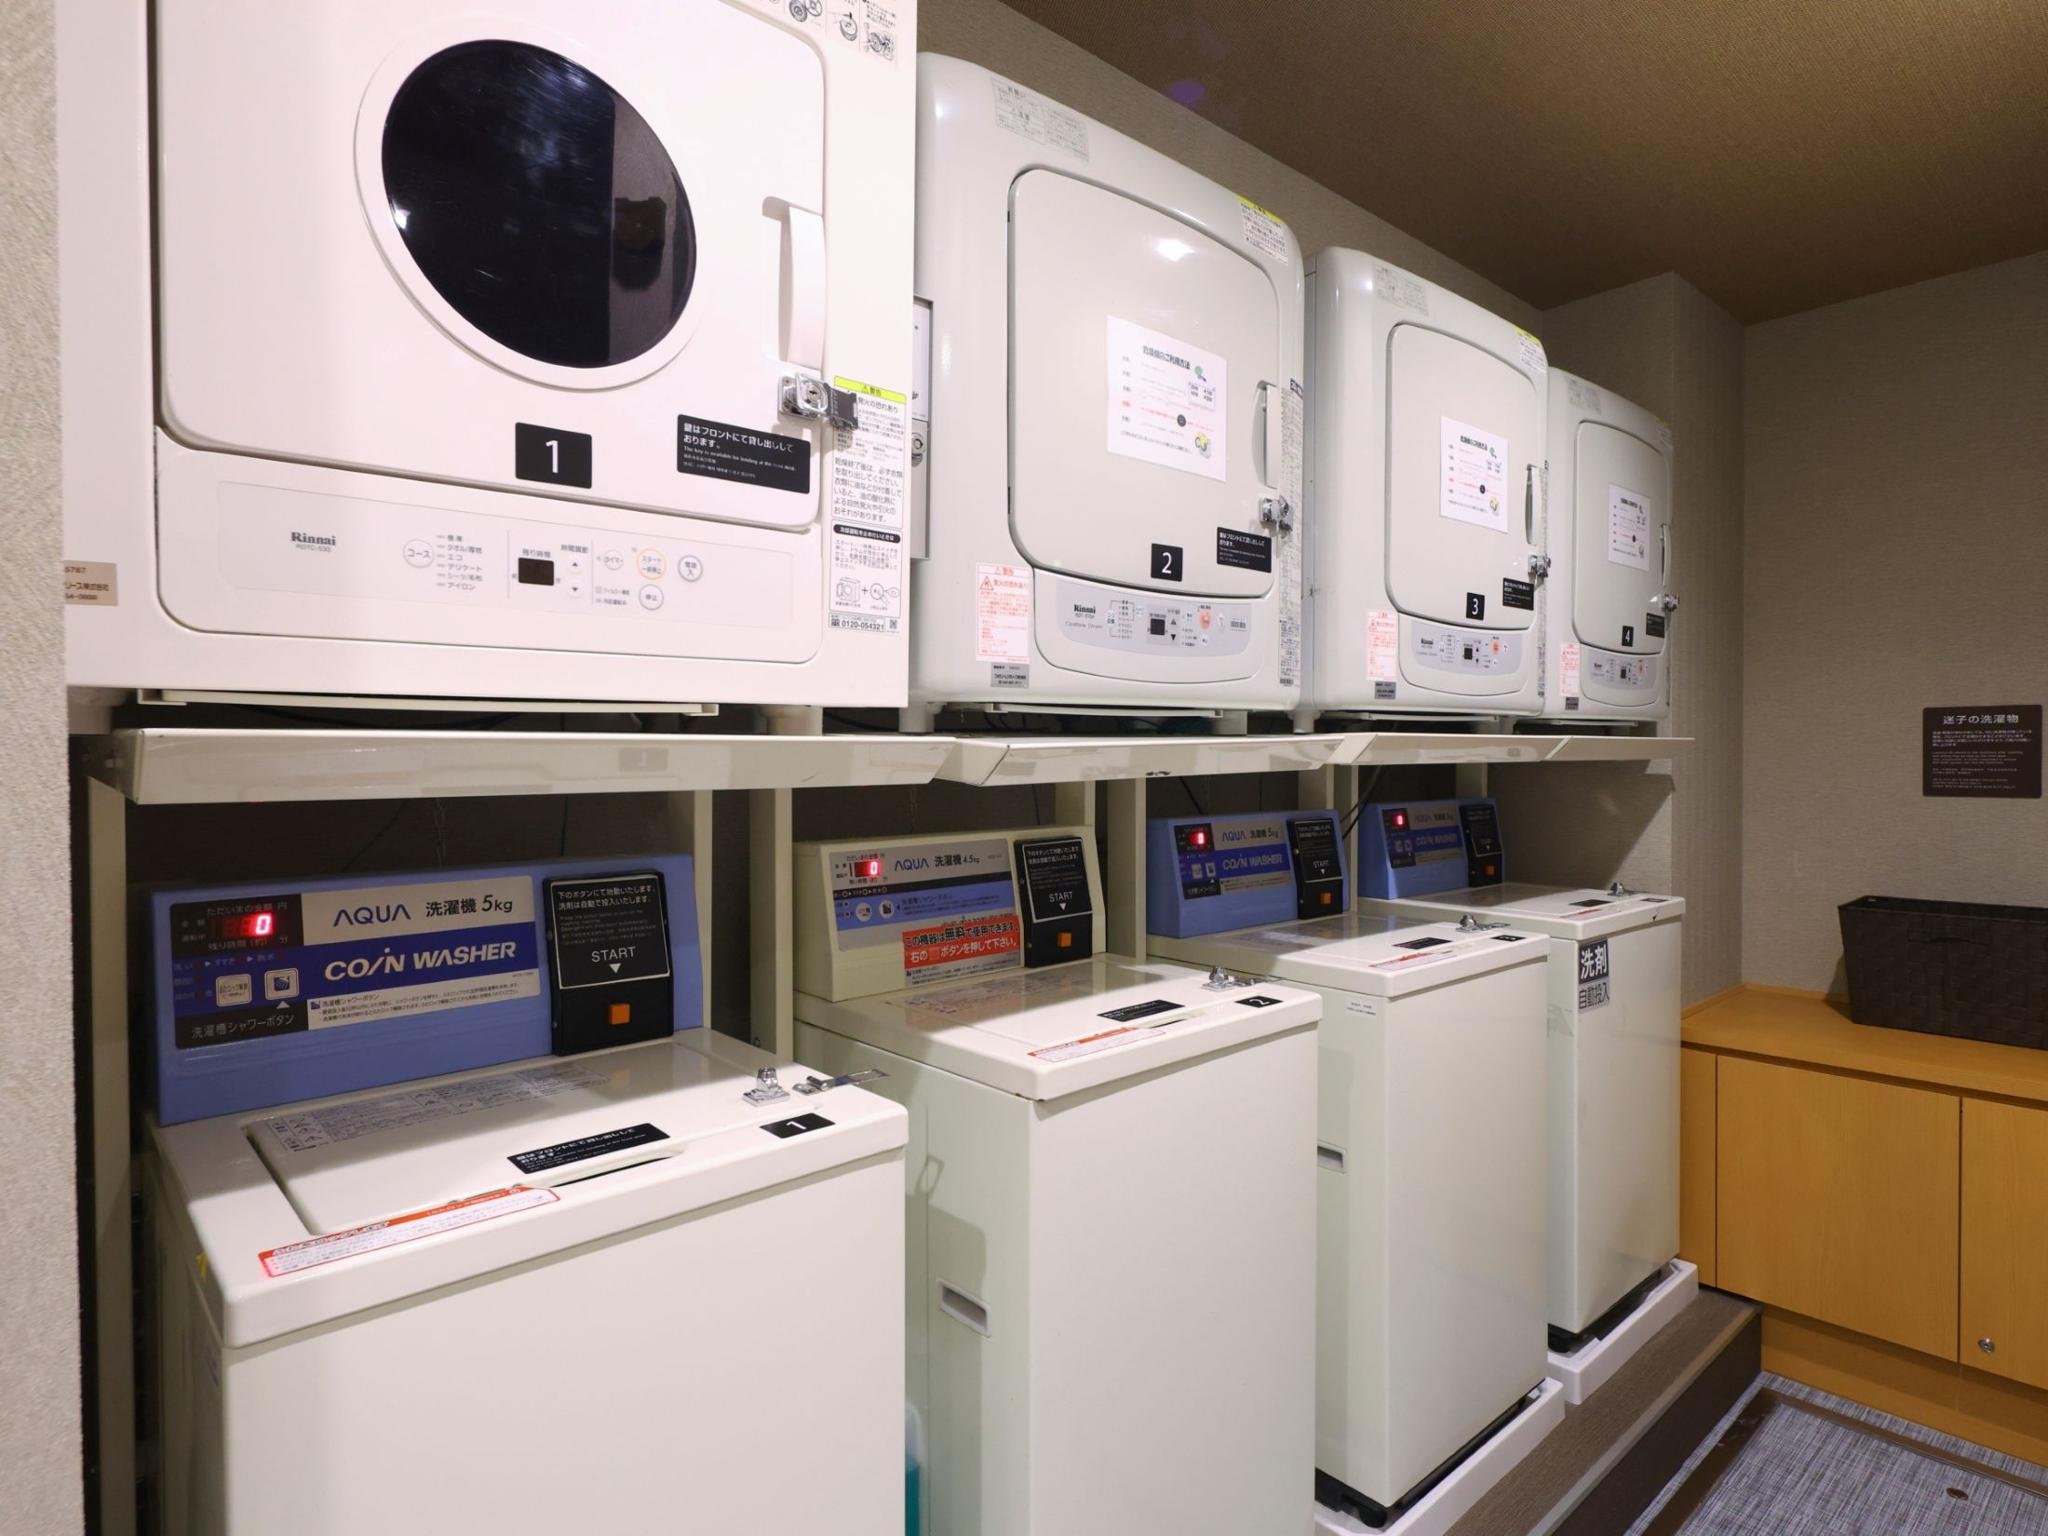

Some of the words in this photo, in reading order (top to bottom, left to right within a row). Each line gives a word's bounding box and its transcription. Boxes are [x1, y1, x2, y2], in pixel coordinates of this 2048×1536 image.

[683, 422, 794, 453] 鍵はフロントにて貸し出しして
[683, 434, 722, 450] おります。
[545, 439, 559, 474] 1
[290, 531, 337, 546] Rinnai
[407, 547, 431, 559] コース
[447, 553, 463, 562] エコ
[641, 555, 662, 564] スタート
[447, 563, 483, 573] デリケート
[1161, 551, 1173, 575] 2
[447, 582, 476, 592] アイロン
[1471, 598, 1479, 616] 3
[1625, 630, 1631, 644] 4
[1943, 714, 2020, 725] 迷子の洗濯物
[1222, 831, 1246, 842] AQUA
[870, 861, 878, 875] 0
[894, 858, 930, 872] AQUA
[934, 854, 962, 868] 洗濯機
[1048, 891, 1073, 903] START
[333, 904, 412, 927] AQUA
[425, 898, 477, 918] 洗濯機
[481, 894, 514, 914] 5kg
[255, 912, 273, 936] 0
[324, 947, 406, 981] COIN
[413, 941, 517, 970] WASHER
[591, 946, 637, 963] START
[1580, 943, 1608, 980] 洗剤
[1249, 998, 1271, 1006] 2
[1579, 981, 1610, 1010] 自動投入
[191, 1014, 295, 1039] 洗濯槽シャワーボタン
[784, 1119, 807, 1131] 1
